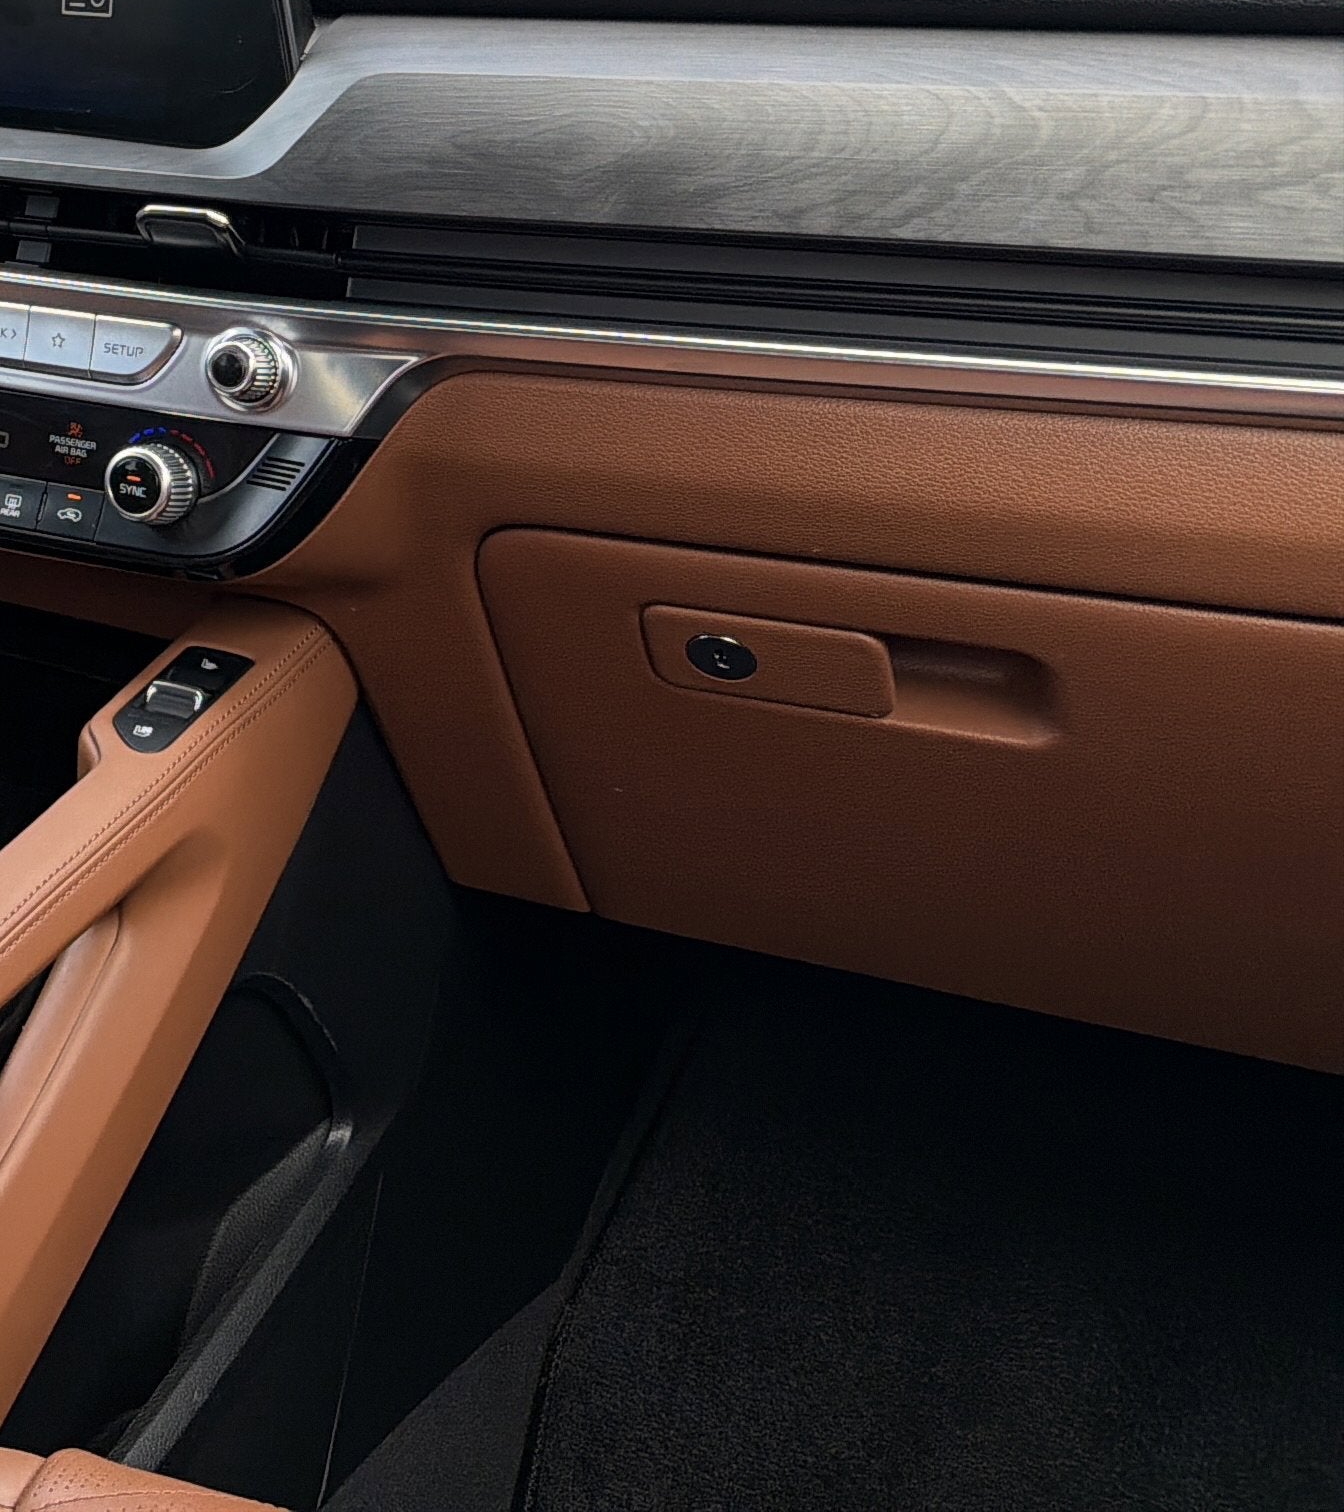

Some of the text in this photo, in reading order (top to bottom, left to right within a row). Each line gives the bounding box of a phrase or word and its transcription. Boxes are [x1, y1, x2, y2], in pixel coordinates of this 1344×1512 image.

[103, 342, 144, 358] SETUP
[49, 434, 96, 451] PASSENGER
[54, 444, 88, 458] AIR BAG
[64, 455, 82, 466] OFF
[119, 483, 147, 499] SYNC
[0, 507, 21, 519] REAR
